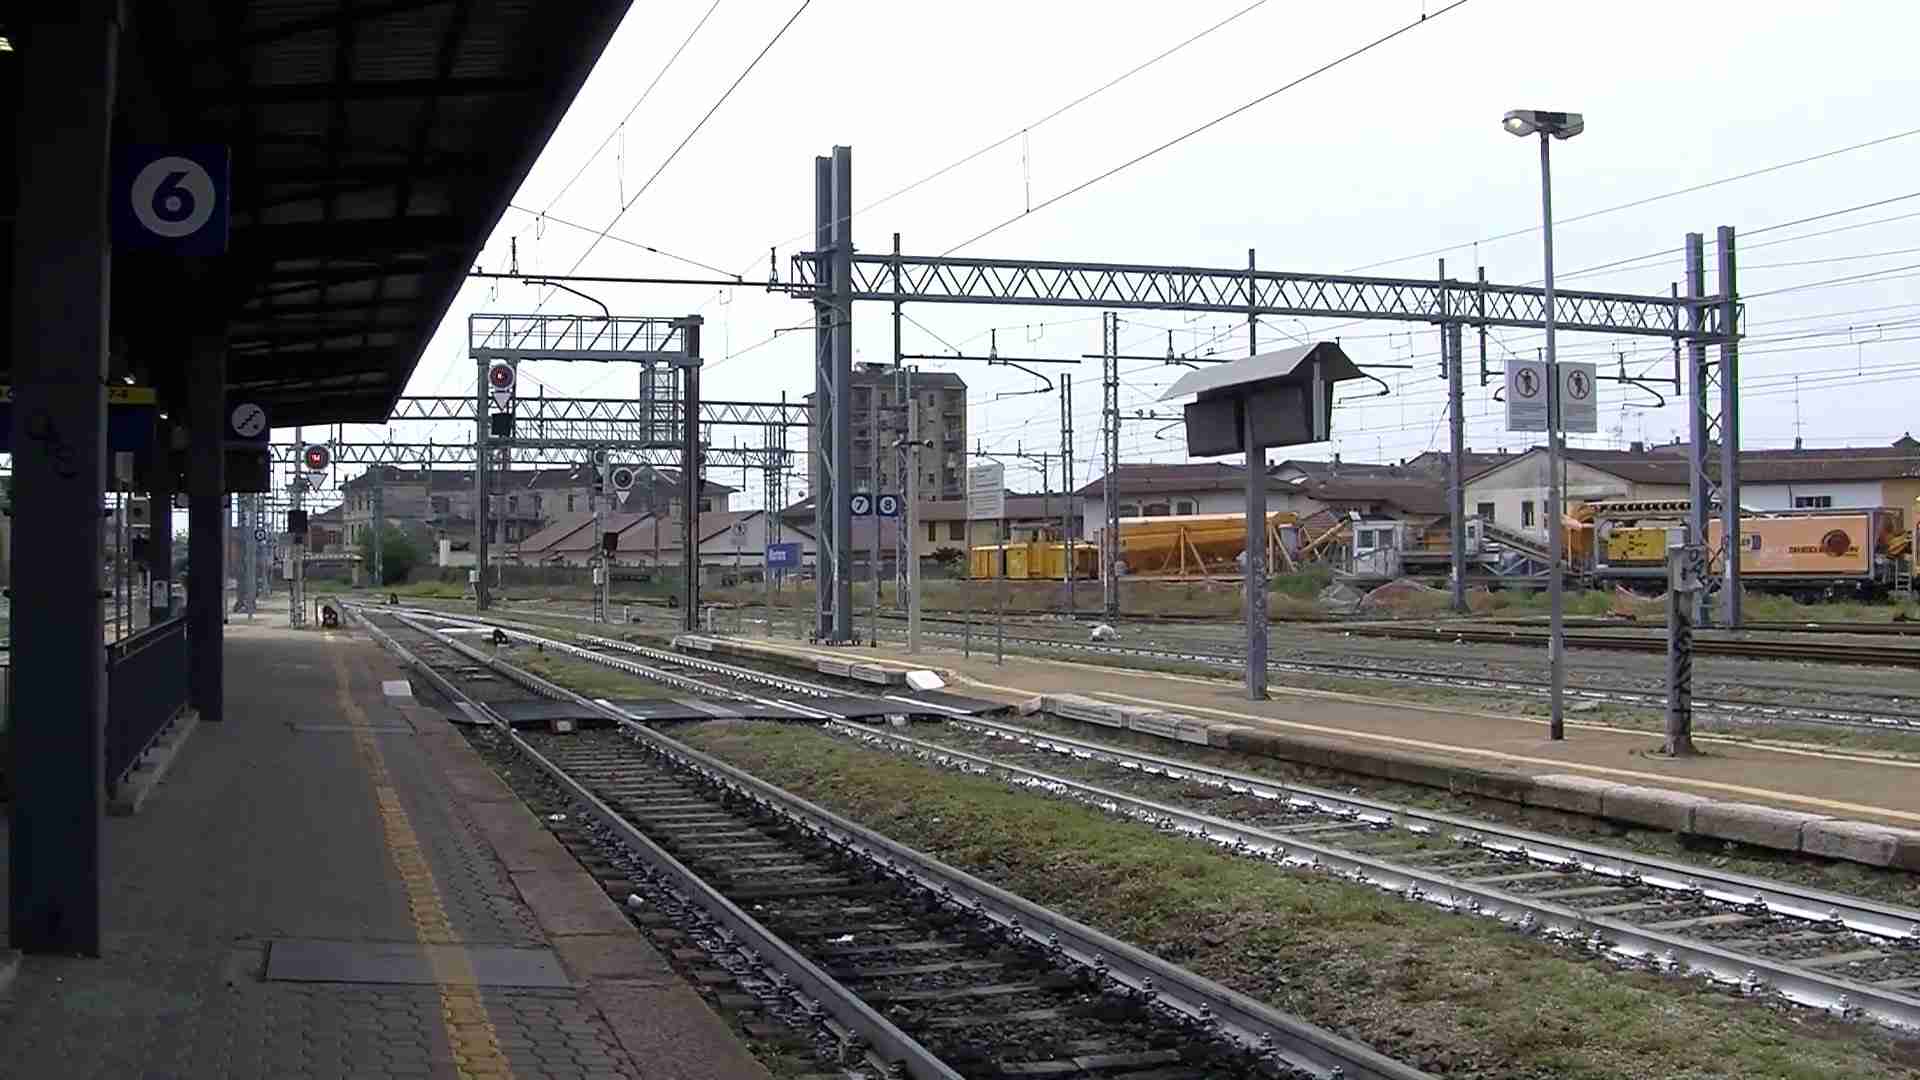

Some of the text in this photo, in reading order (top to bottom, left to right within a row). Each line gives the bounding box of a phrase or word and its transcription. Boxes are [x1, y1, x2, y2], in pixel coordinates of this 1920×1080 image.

[151, 170, 195, 222] 6
[855, 498, 864, 511] 7
[883, 498, 893, 511] 8
